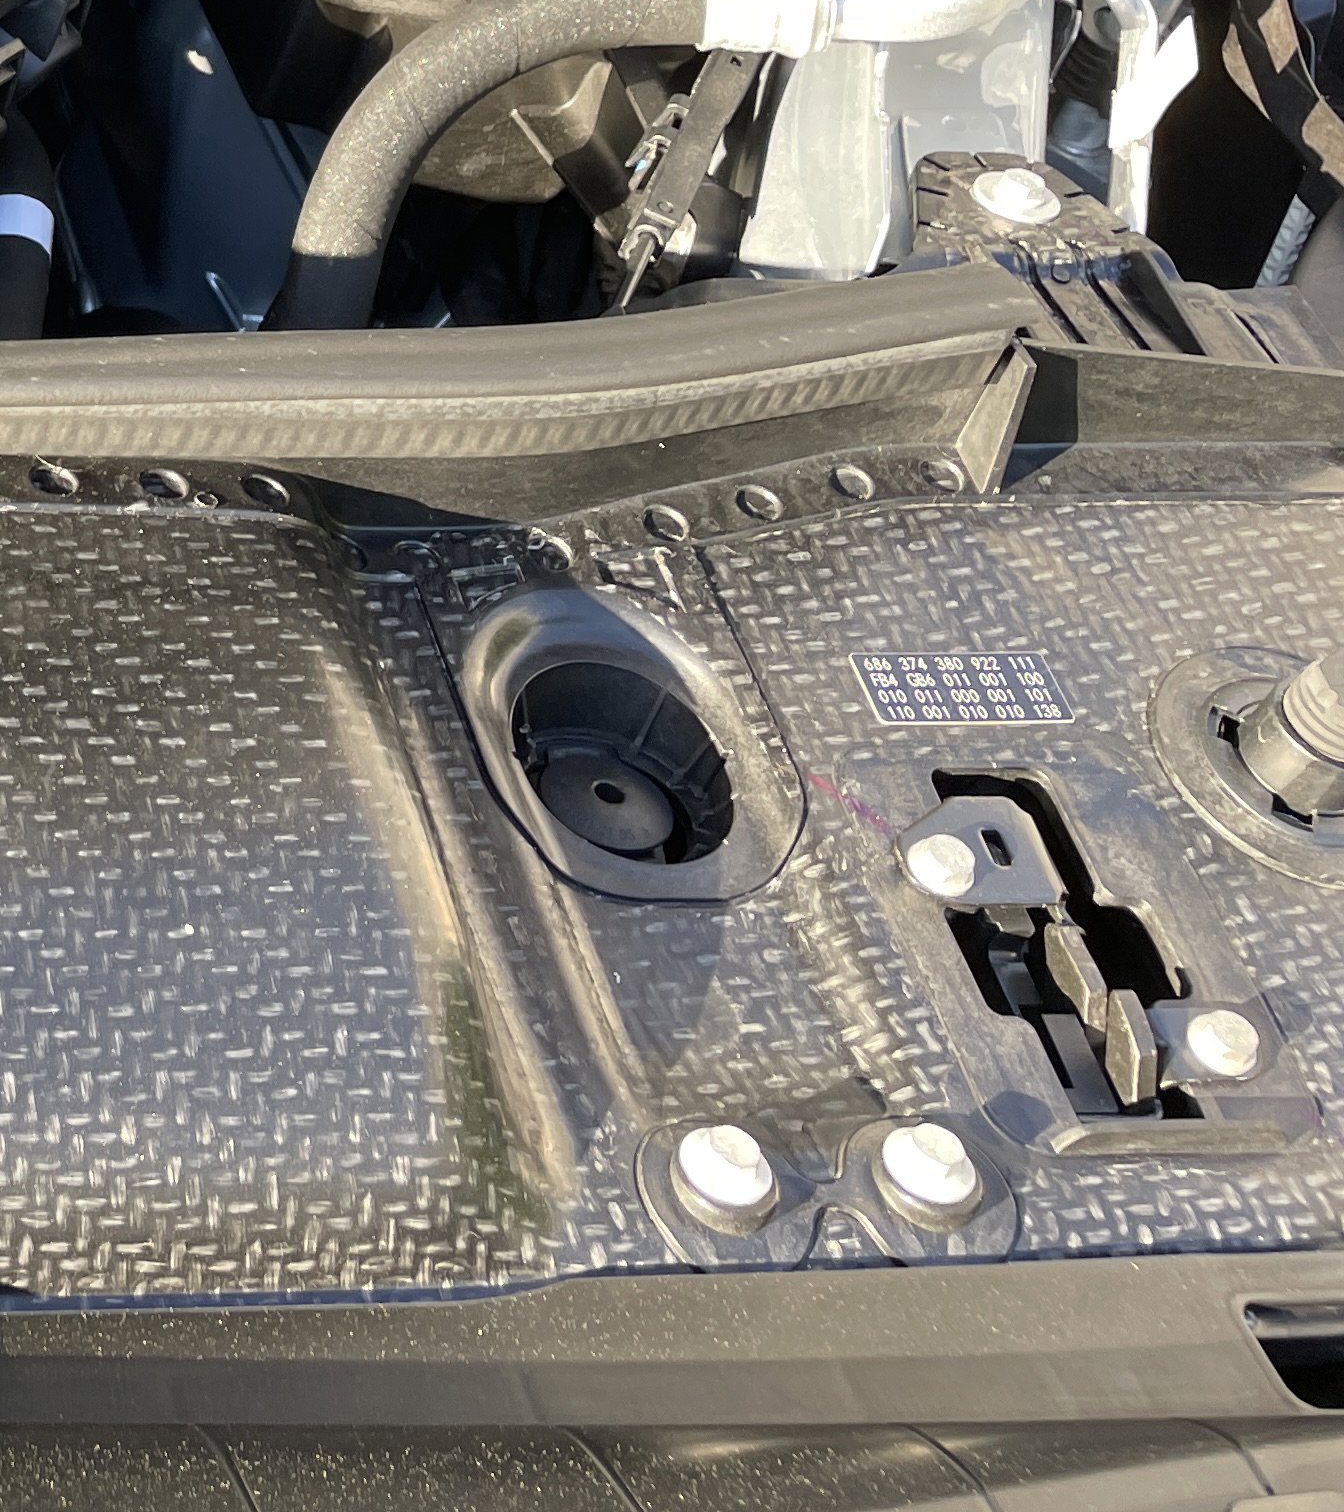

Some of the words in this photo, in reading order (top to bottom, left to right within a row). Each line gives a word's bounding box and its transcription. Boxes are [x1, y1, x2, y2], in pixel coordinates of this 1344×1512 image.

[864, 656, 892, 671] 686
[898, 656, 928, 671] 374
[934, 656, 964, 671] 380
[970, 656, 1001, 670] 922
[1008, 656, 1036, 670] 111
[870, 672, 898, 688] FB4
[906, 672, 936, 687] GB6
[942, 672, 972, 686] 011
[978, 672, 1008, 686] 001
[1016, 672, 1044, 686] 100
[878, 689, 908, 704] 010
[914, 689, 943, 704] 011
[950, 689, 980, 703] 000
[986, 688, 1016, 702] 001
[1024, 688, 1052, 702] 101
[886, 705, 916, 720] 110
[922, 705, 951, 720] 001
[958, 705, 988, 719] 010
[994, 704, 1025, 718] 010
[1033, 704, 1062, 718] 138
